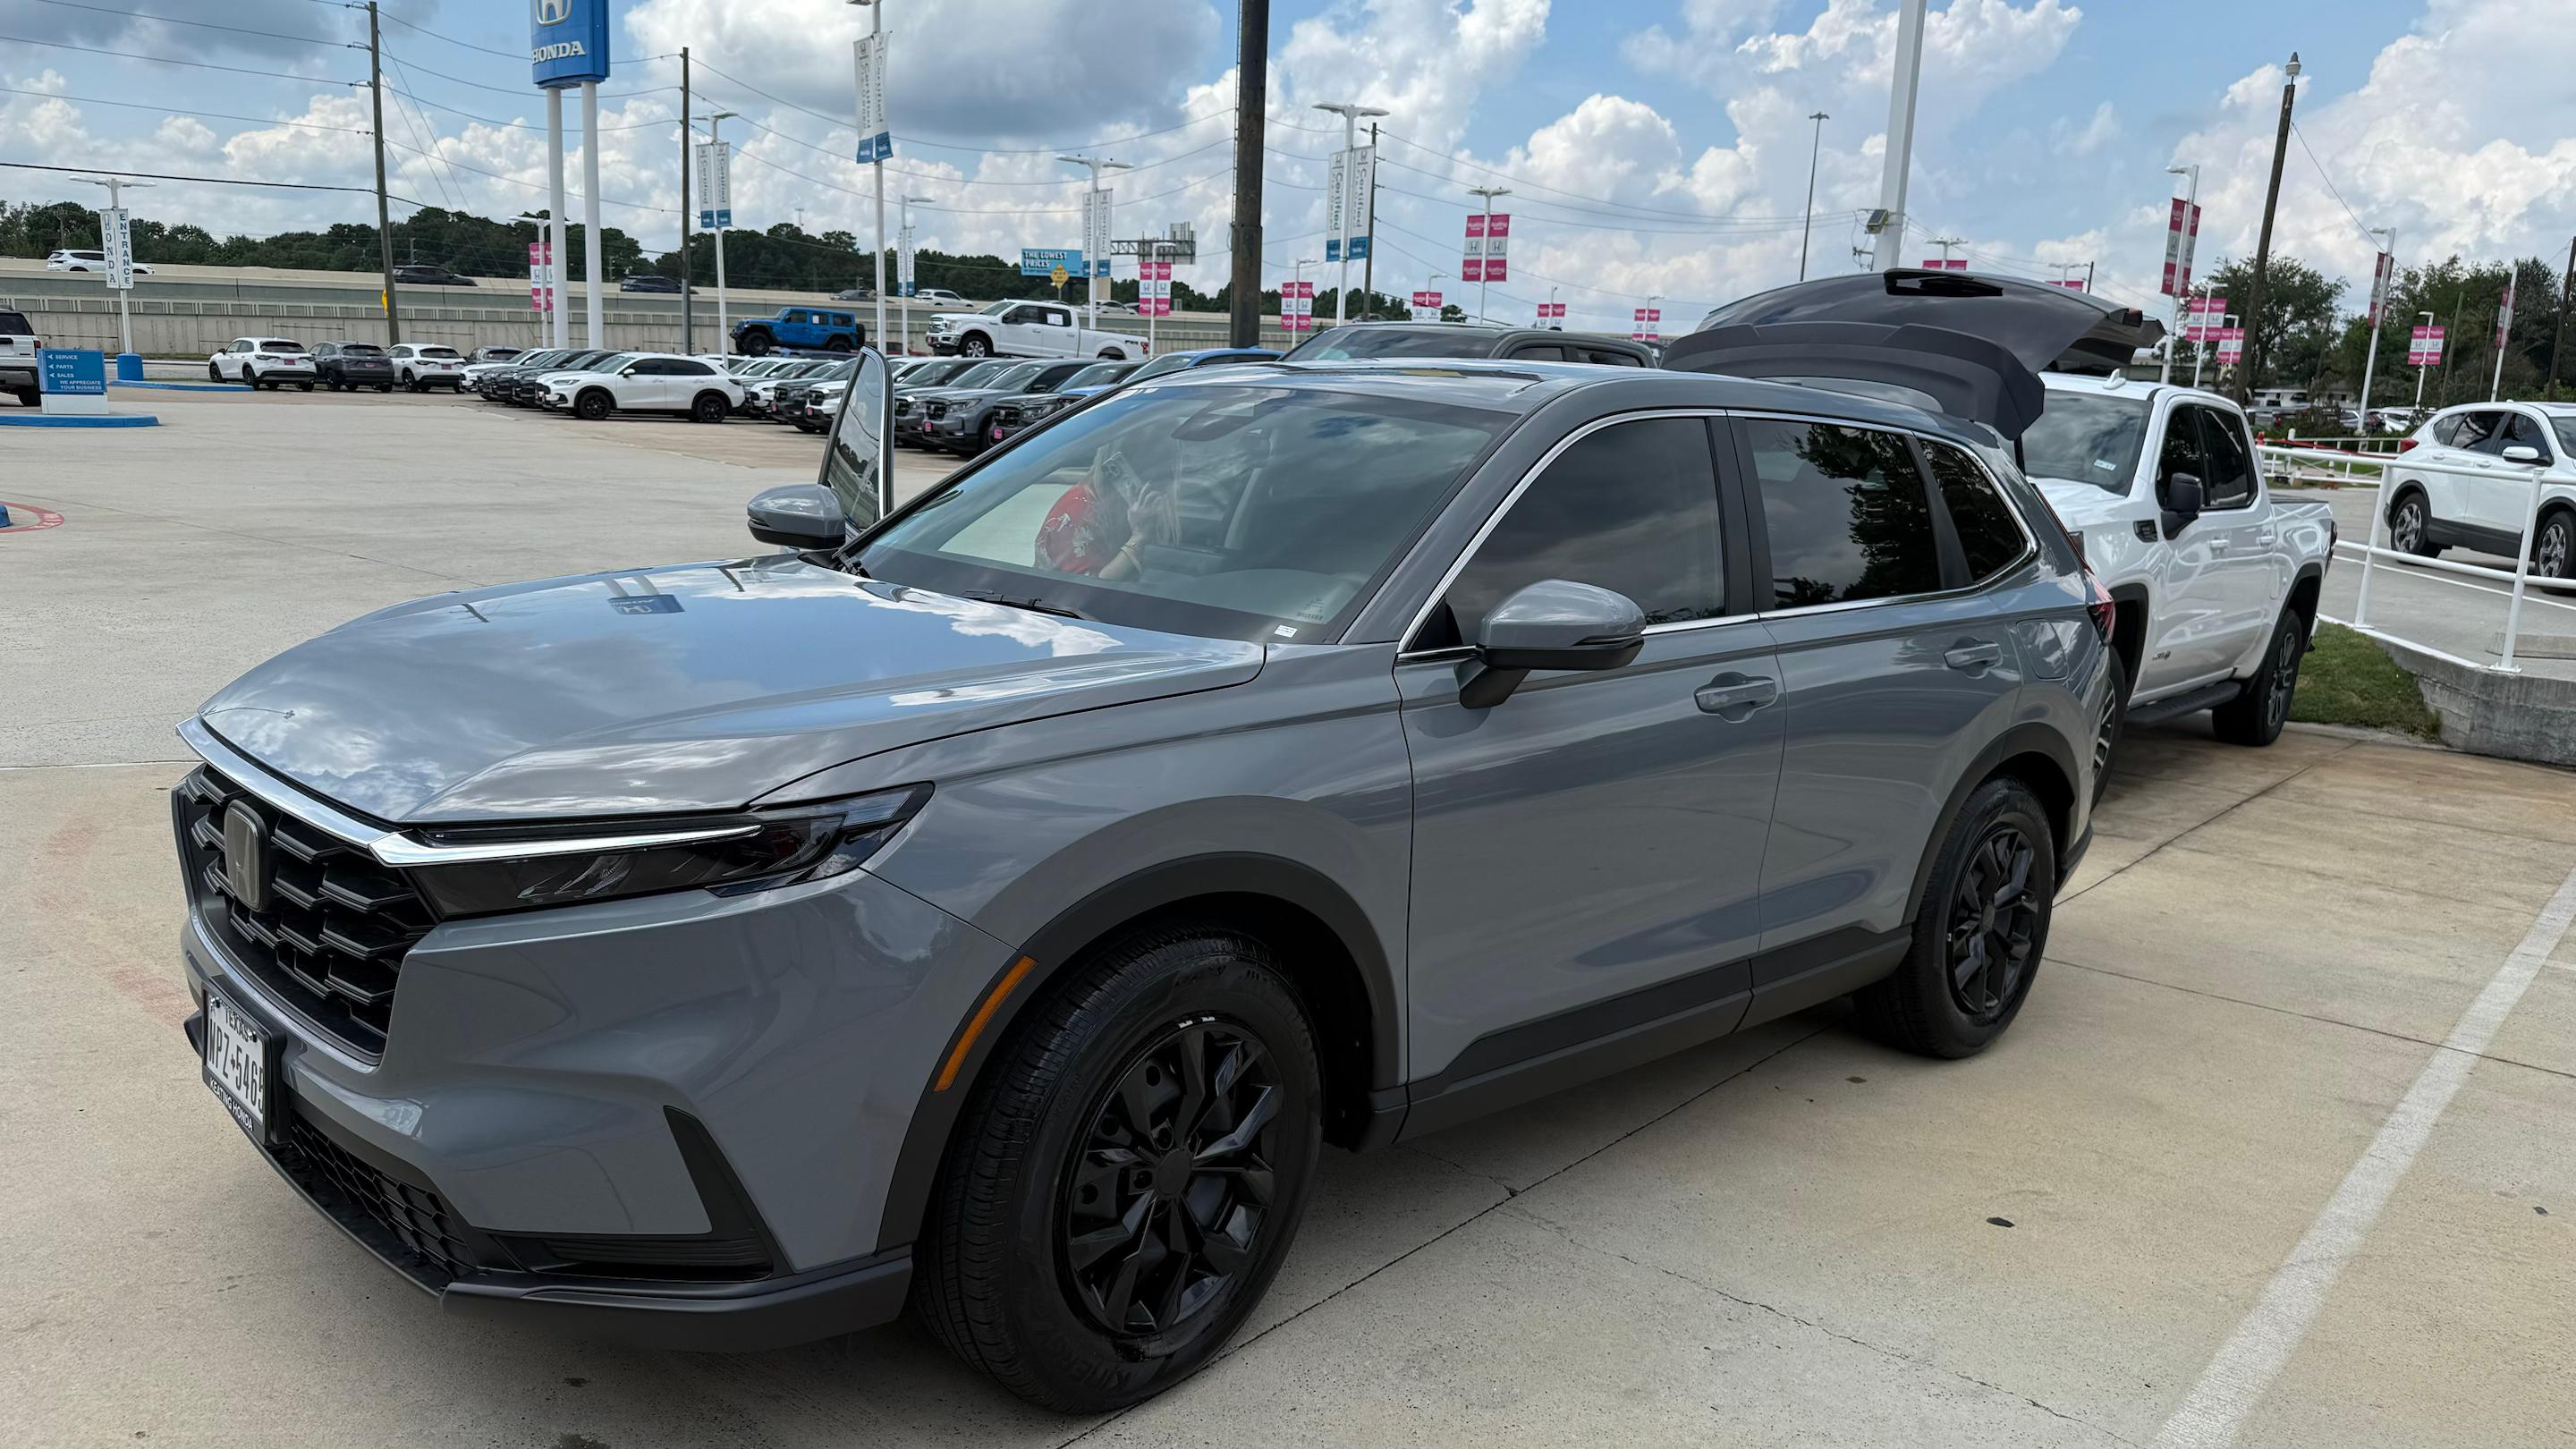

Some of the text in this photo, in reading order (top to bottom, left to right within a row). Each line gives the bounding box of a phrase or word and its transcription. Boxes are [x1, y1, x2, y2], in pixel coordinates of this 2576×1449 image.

[531, 40, 586, 65] HONDA
[119, 213, 131, 284] ENTRANCE
[1022, 250, 1067, 260] THE LOWEST
[225, 1007, 249, 1043] TEXAS
[209, 1076, 253, 1131] KEATING HONDA
